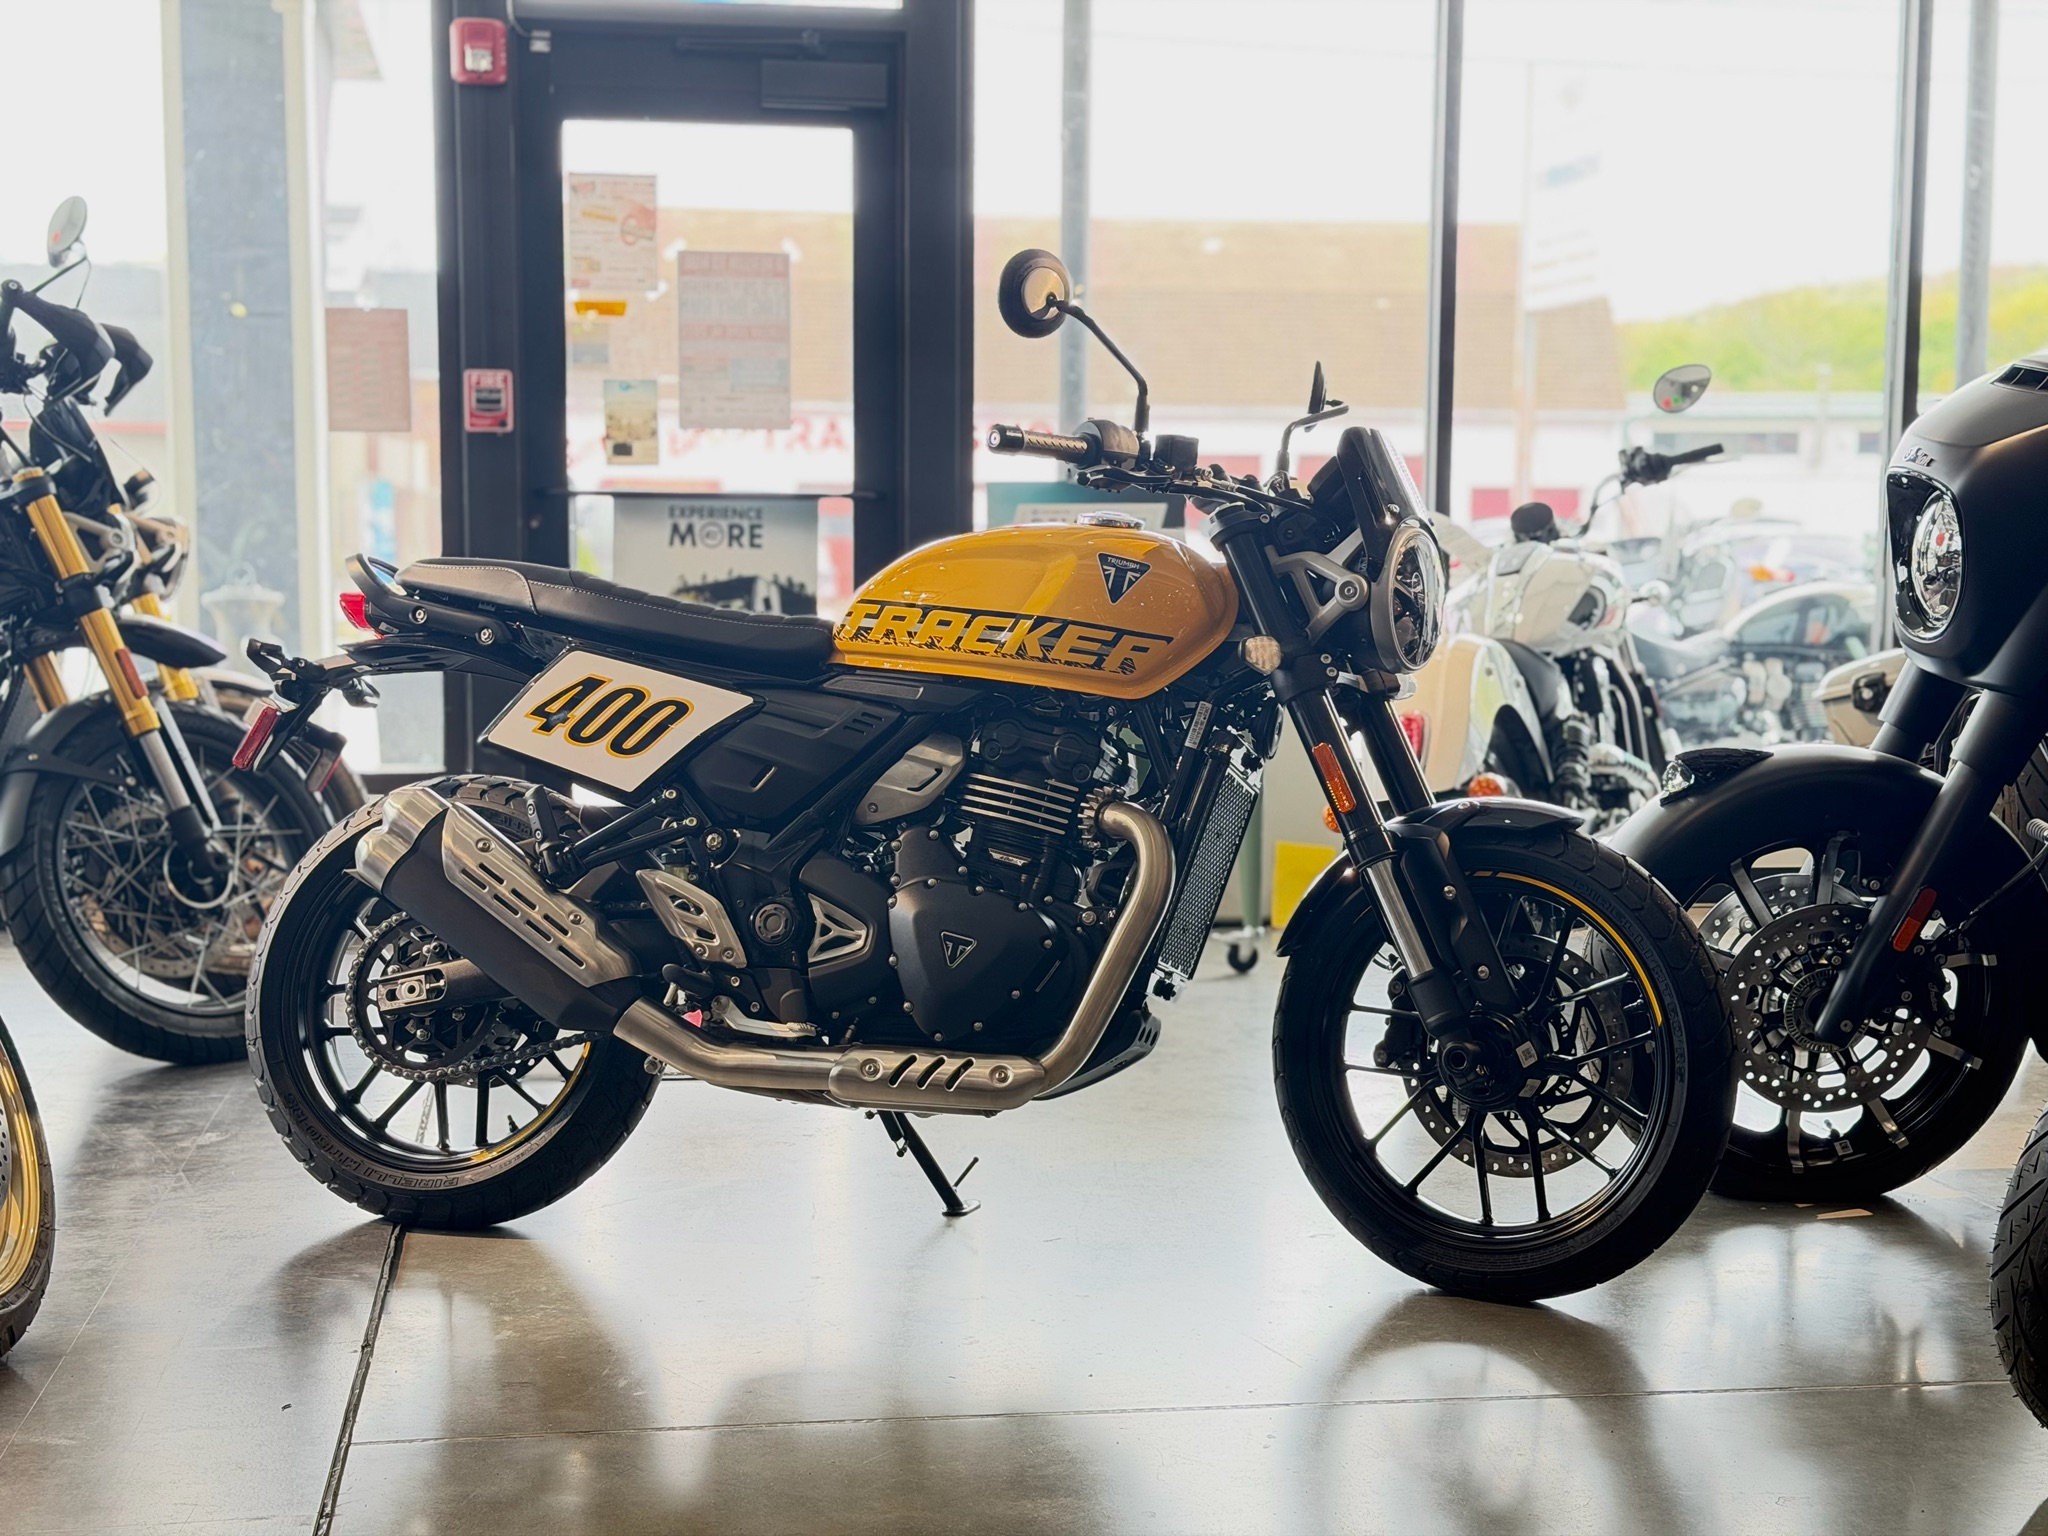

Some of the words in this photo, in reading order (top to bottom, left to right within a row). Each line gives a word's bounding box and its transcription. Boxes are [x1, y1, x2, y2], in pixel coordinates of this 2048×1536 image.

[668, 505, 764, 520] EXPERIENCE
[1107, 556, 1140, 570] TRIUMPH
[845, 599, 1174, 676] TRACKER
[523, 673, 695, 759] 400
[361, 1166, 461, 1189] PIRELLI
